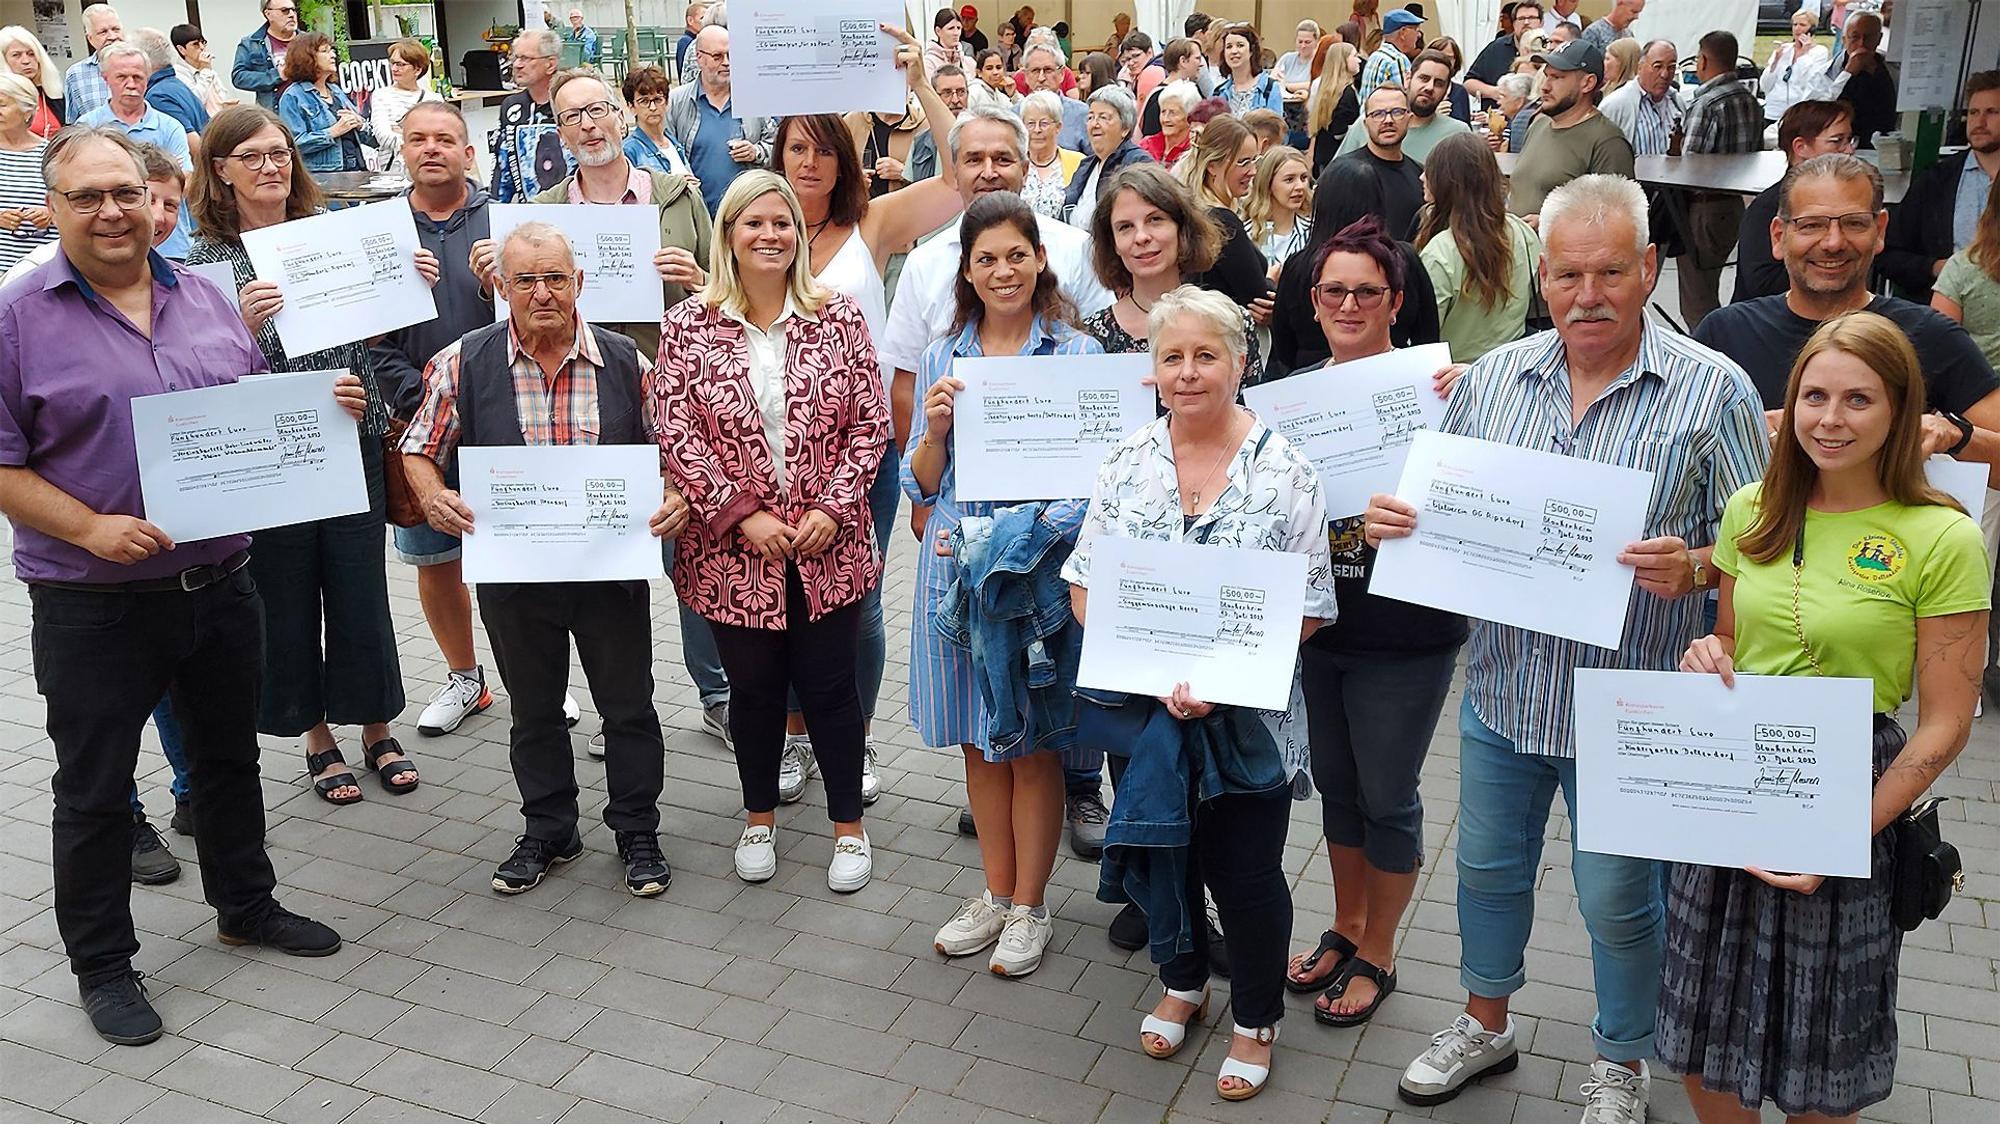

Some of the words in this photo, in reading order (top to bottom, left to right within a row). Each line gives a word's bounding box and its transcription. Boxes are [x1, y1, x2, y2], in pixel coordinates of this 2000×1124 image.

[1376, 402, 1418, 414] Blankenheim
[1407, 408, 1422, 416] 2023
[1328, 410, 1346, 418] Euro
[276, 426, 318, 435] Blankenheim
[542, 484, 560, 492] Euro
[1490, 493, 1511, 506] Euro
[1486, 511, 1525, 528] Ripsdorf
[1543, 515, 1592, 533] Blankenheim
[1576, 534, 1593, 543] 2023
[1333, 564, 1366, 578] SEIN
[1838, 578, 1856, 589] Alina
[1172, 586, 1191, 596] Euro
[1220, 601, 1263, 612] Blankenheim
[1690, 727, 1714, 738] Euro
[1625, 744, 1679, 756] Kindergarten
[1682, 747, 1734, 762] Dollendorf
[1754, 742, 1815, 754] Blankenheim
[1797, 757, 1817, 765] 2023
